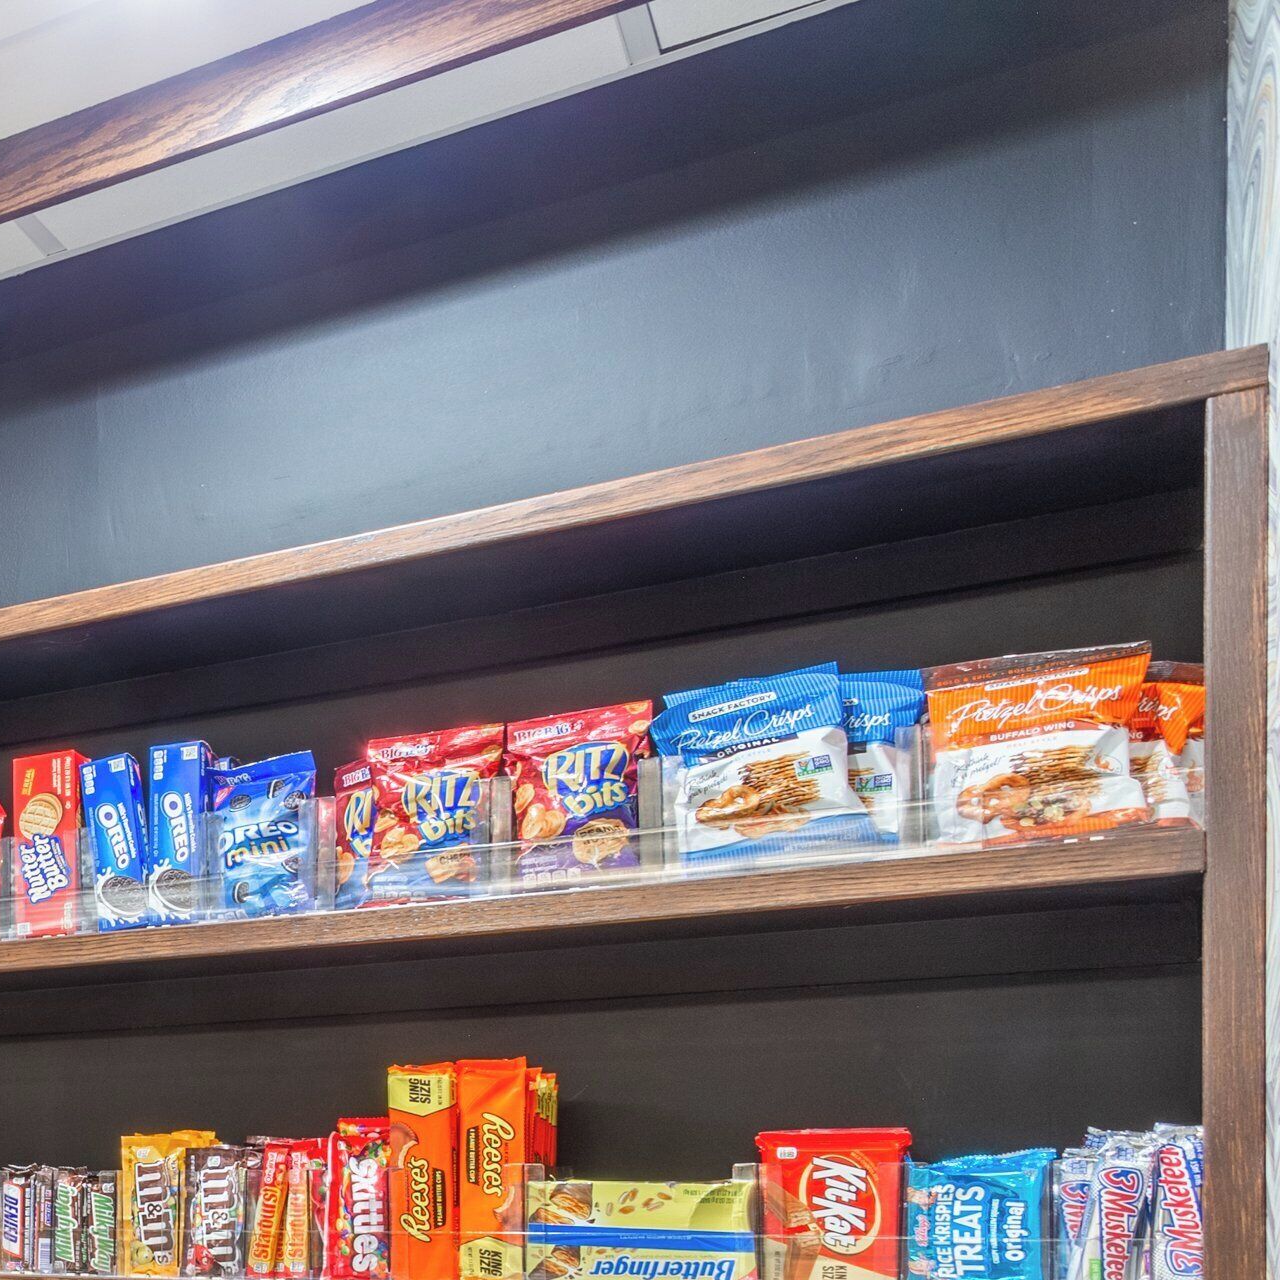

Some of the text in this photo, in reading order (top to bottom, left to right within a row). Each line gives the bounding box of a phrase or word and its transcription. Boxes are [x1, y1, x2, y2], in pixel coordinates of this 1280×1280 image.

[670, 704, 815, 752] Pretzel Crisps
[692, 693, 772, 721] SNACK FACTORY
[946, 683, 1122, 737] Pretzel Crisps
[515, 729, 541, 743] BIG
[717, 737, 780, 758] ORIGINAL
[990, 721, 1075, 742] BUFFALO WING
[545, 743, 628, 795] RITZ
[402, 771, 480, 817] RITZ
[564, 781, 627, 816] bits
[96, 803, 130, 869] OREO
[160, 791, 190, 863] OREO
[217, 820, 298, 851] OREO
[420, 808, 476, 844] bits
[225, 836, 289, 869] mini
[409, 1078, 419, 1103] KING
[420, 1079, 430, 1104] SIZE
[482, 1112, 515, 1197] Reese's
[3, 1193, 18, 1244] DENIED
[352, 1158, 379, 1272] Skittles
[400, 1156, 431, 1242] Reese's
[252, 1186, 280, 1260] Starburst
[933, 1184, 956, 1278] RICE KRISPIES
[953, 1186, 986, 1276] TREATS
[479, 1249, 490, 1275] SIZE
[491, 1250, 502, 1277] KING
